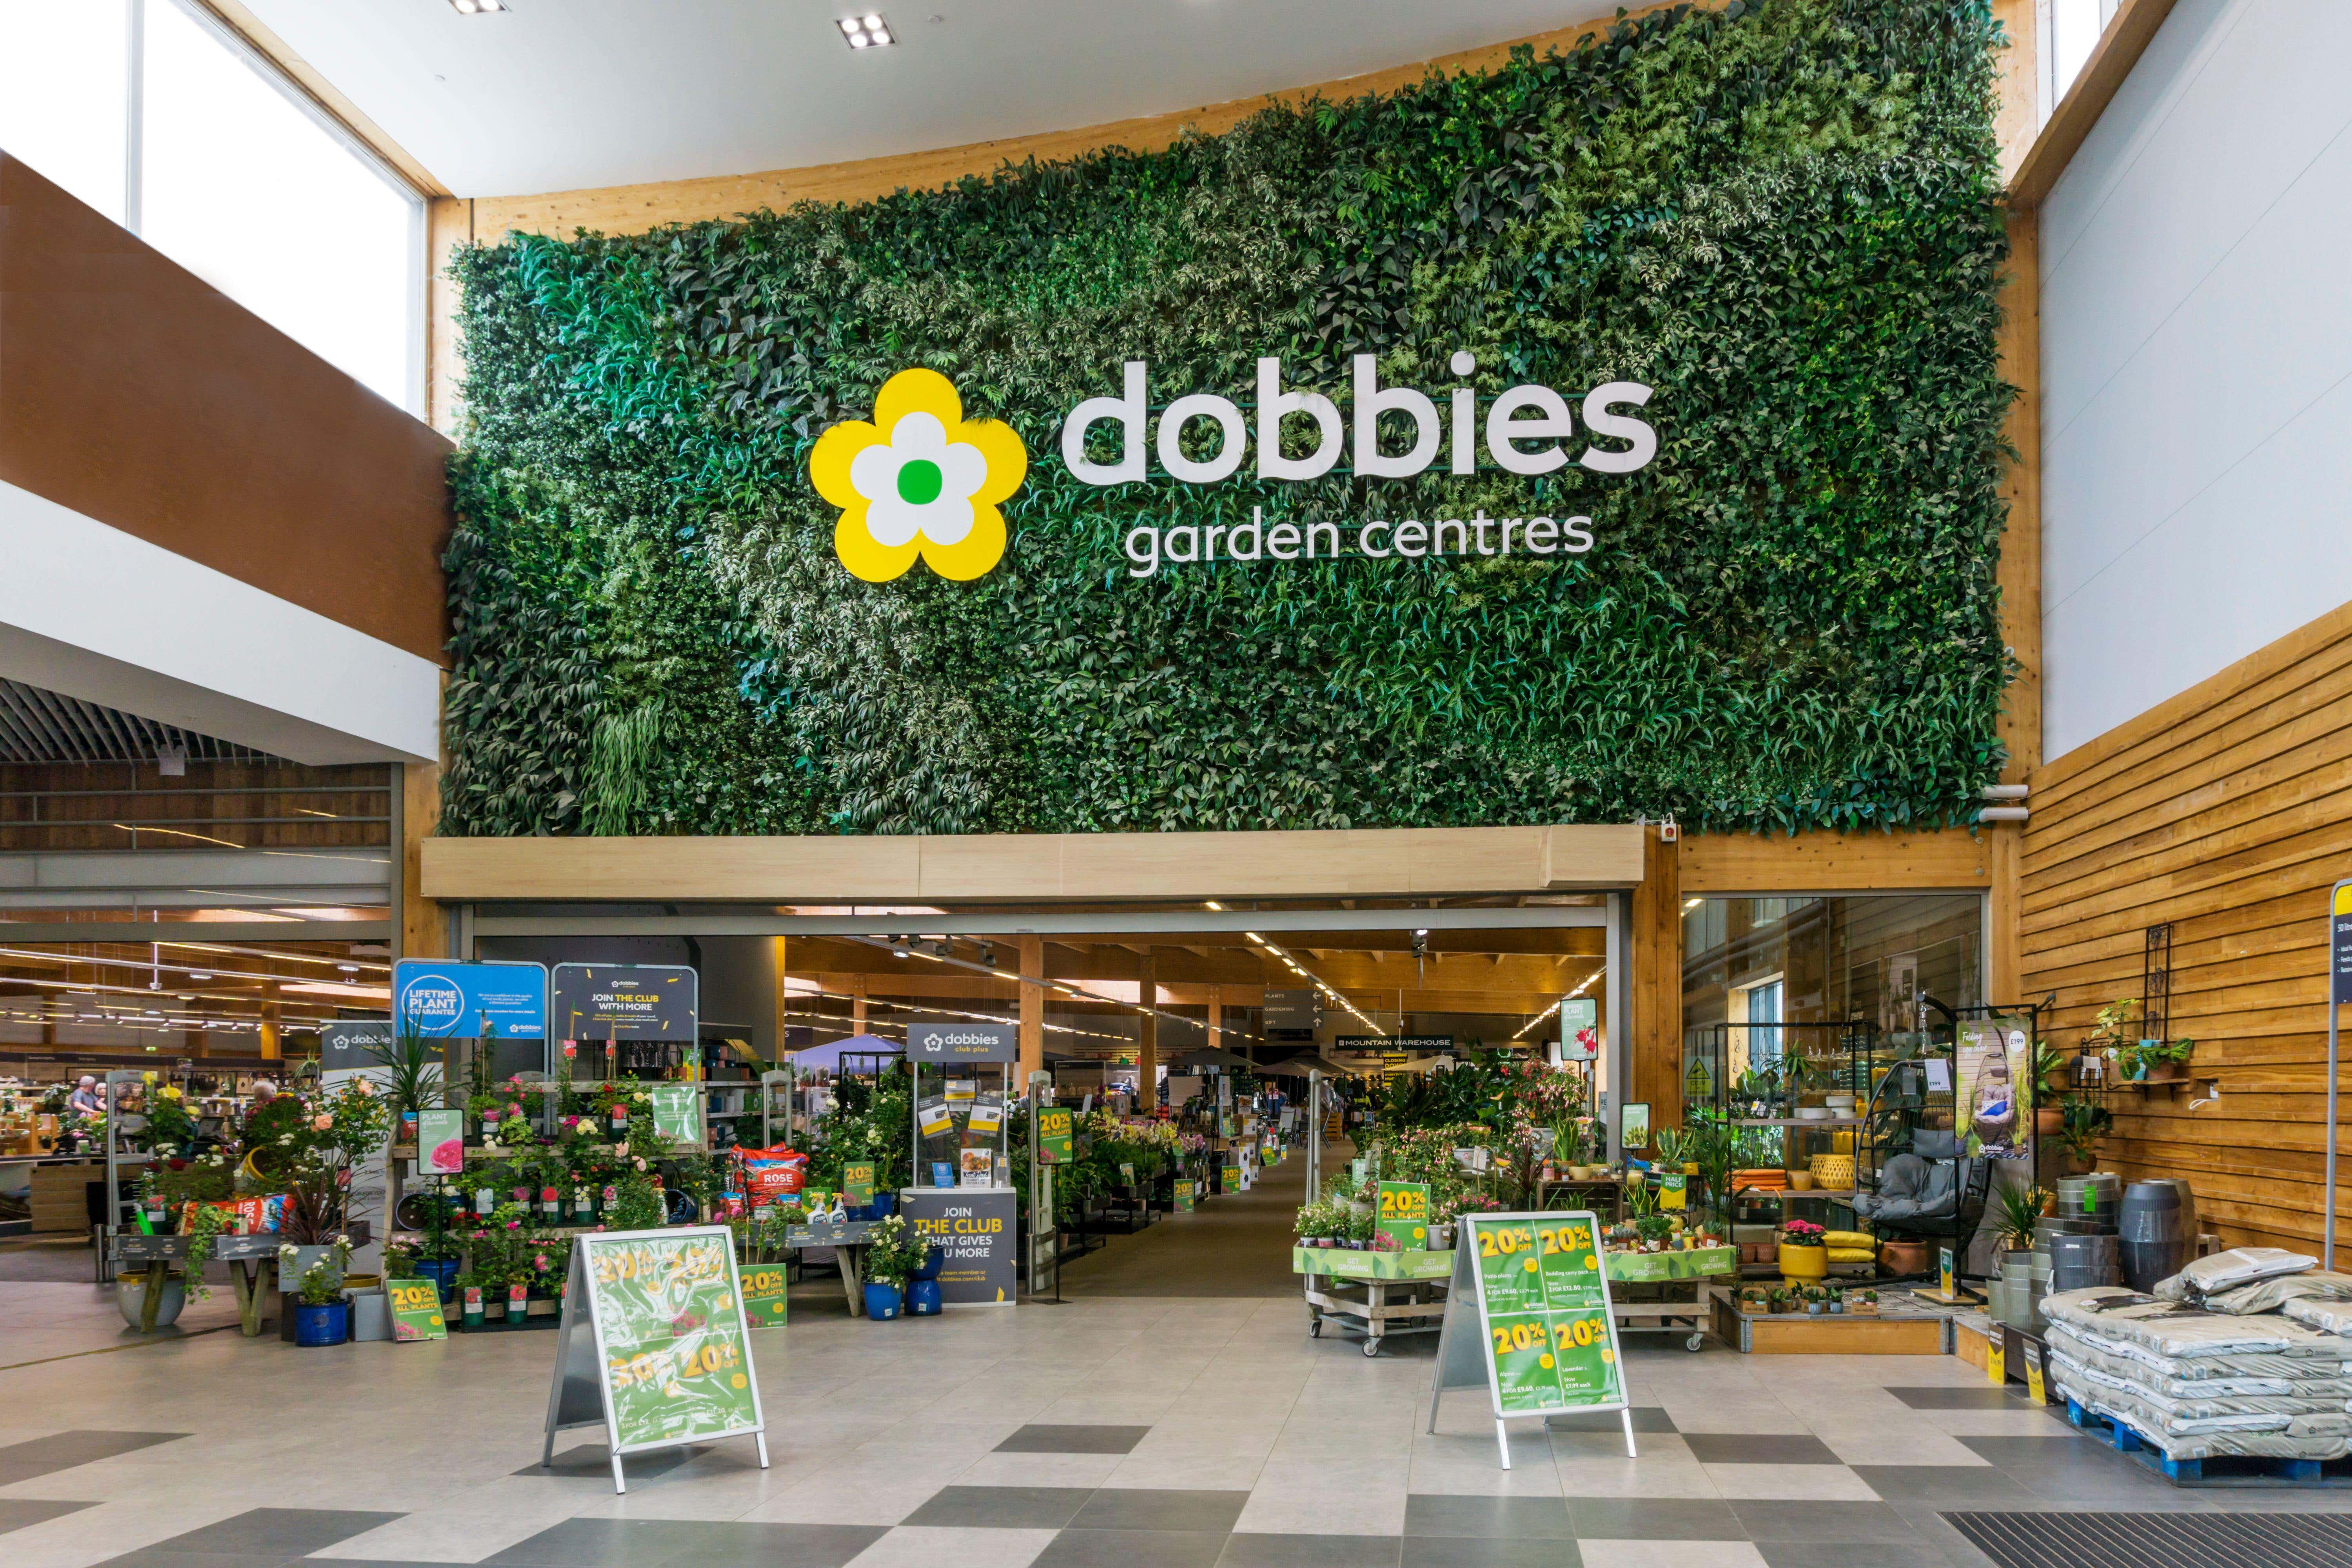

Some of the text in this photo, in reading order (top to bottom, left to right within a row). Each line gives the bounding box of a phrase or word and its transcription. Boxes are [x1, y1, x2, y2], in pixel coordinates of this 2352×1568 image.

[1062, 351, 1658, 486] dobbies
[1125, 506, 1594, 578] garden centres
[410, 990, 456, 998] LIFETIME
[410, 999, 456, 1009] PLANT
[945, 1033, 998, 1045] dobbies
[1962, 1032, 1984, 1046] Folding
[1963, 1047, 1972, 1059] egg
[1040, 1113, 1070, 1131] 20%
[764, 1174, 793, 1183] ROSE
[846, 1166, 872, 1180] 20%
[1223, 1169, 1239, 1178] 20%
[1175, 1183, 1193, 1194] 20%
[1381, 1191, 1426, 1211] 20%
[944, 1207, 972, 1217] JOIN
[914, 1218, 1002, 1234] THE CLUB
[925, 1236, 992, 1246] THAT GIVES
[1478, 1227, 1531, 1258] 20%
[1540, 1225, 1590, 1255] 20%
[956, 1248, 989, 1257] MORE
[1518, 1243, 1532, 1252] OFF
[741, 1271, 782, 1292] 20%
[391, 1287, 434, 1305] 20%
[757, 1289, 783, 1297] PLANTS
[1493, 1322, 1546, 1355] 20%
[1555, 1318, 1606, 1350] 20%
[1533, 1339, 1546, 1347] OFF
[681, 1342, 738, 1377] 20%
[723, 1359, 739, 1368] OFF
